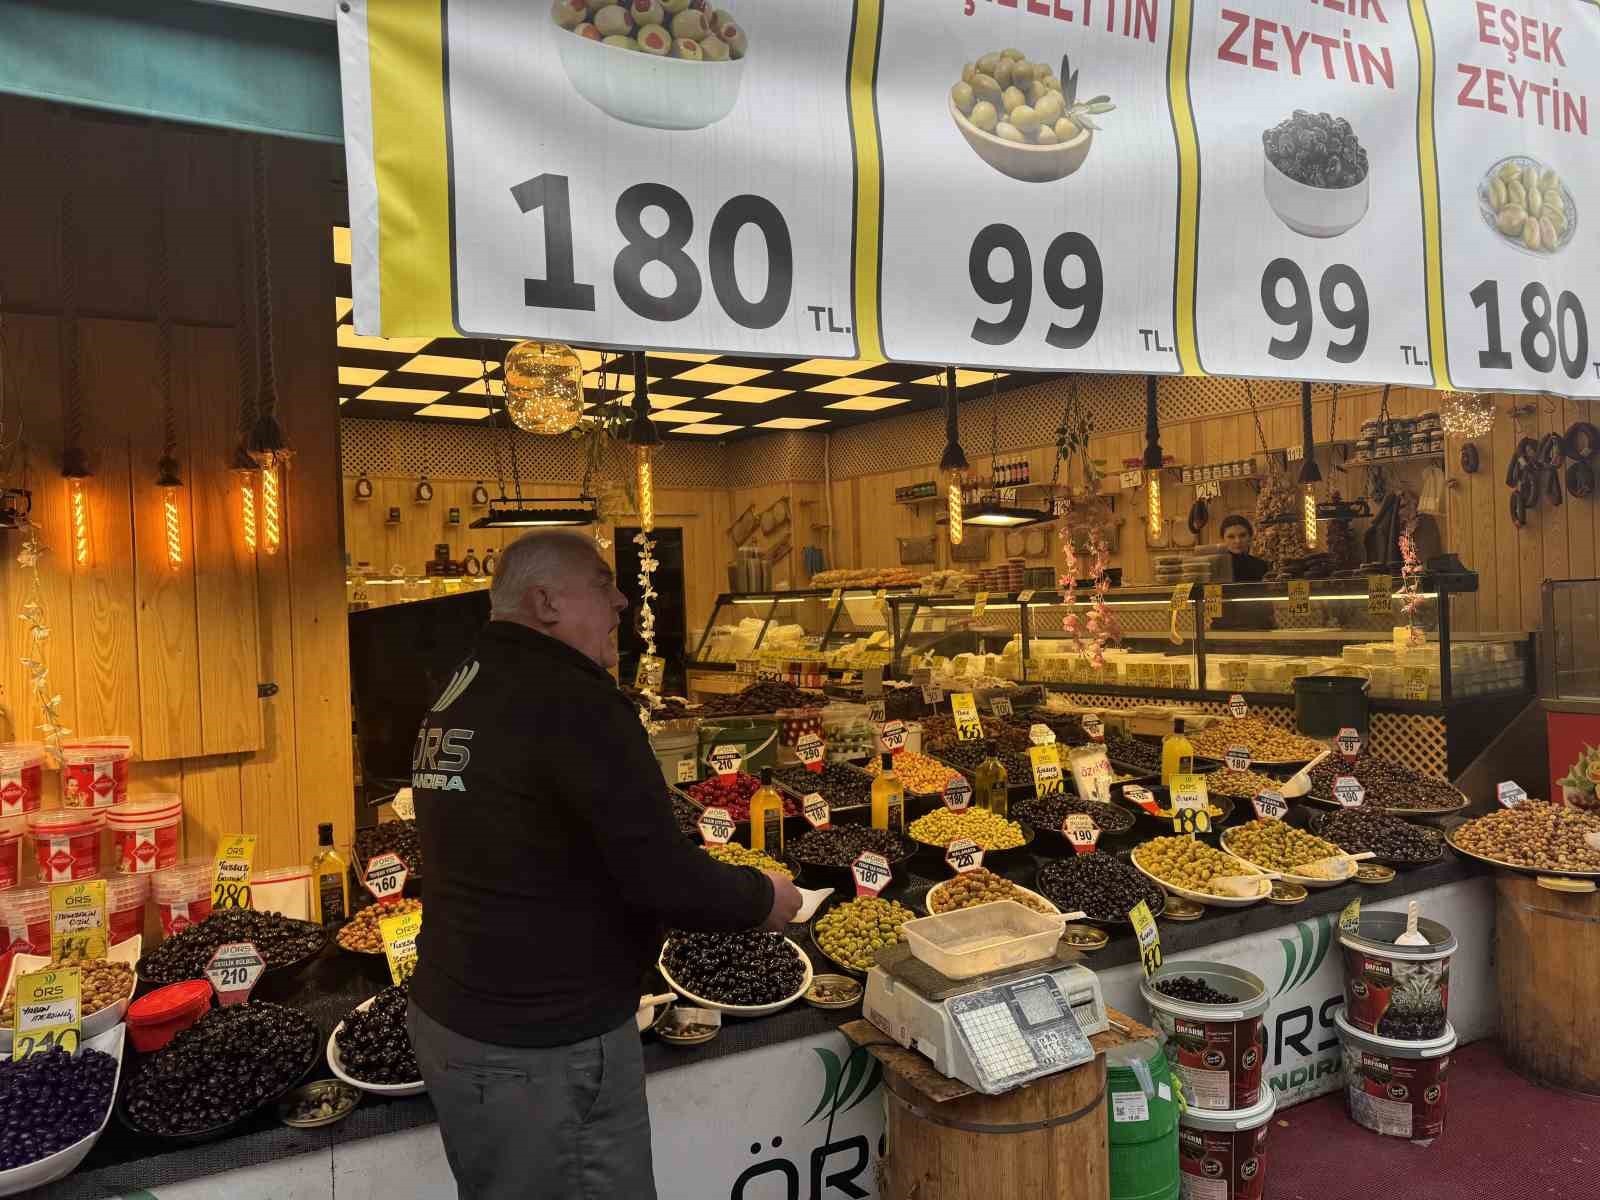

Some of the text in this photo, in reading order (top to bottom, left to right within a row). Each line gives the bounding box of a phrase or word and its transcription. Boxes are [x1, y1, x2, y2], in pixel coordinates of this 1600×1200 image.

[1476, 1, 1566, 67] EŞEK
[1218, 8, 1395, 89] ZEYTİN
[1457, 63, 1588, 135] ZEYTİN
[510, 173, 851, 334] 180 TL.
[969, 223, 1173, 352] 99 TL.
[1261, 257, 1428, 366] 99 TL.
[1469, 280, 1589, 379] 180
[718, 759, 733, 771] 210
[1174, 808, 1209, 832] 180
[1260, 804, 1277, 816] 180
[711, 825, 729, 838] 200
[1073, 831, 1092, 841] 190
[956, 855, 974, 867] 220
[376, 875, 397, 892] 160
[860, 869, 878, 884] 180
[65, 895, 91, 905] ÖRS
[213, 883, 252, 910] 280
[220, 967, 248, 985] 210
[33, 985, 64, 998] ÖRS
[1261, 995, 1344, 1066] RS
[17, 1029, 81, 1063] 240
[731, 1136, 886, 1200] ÖR
